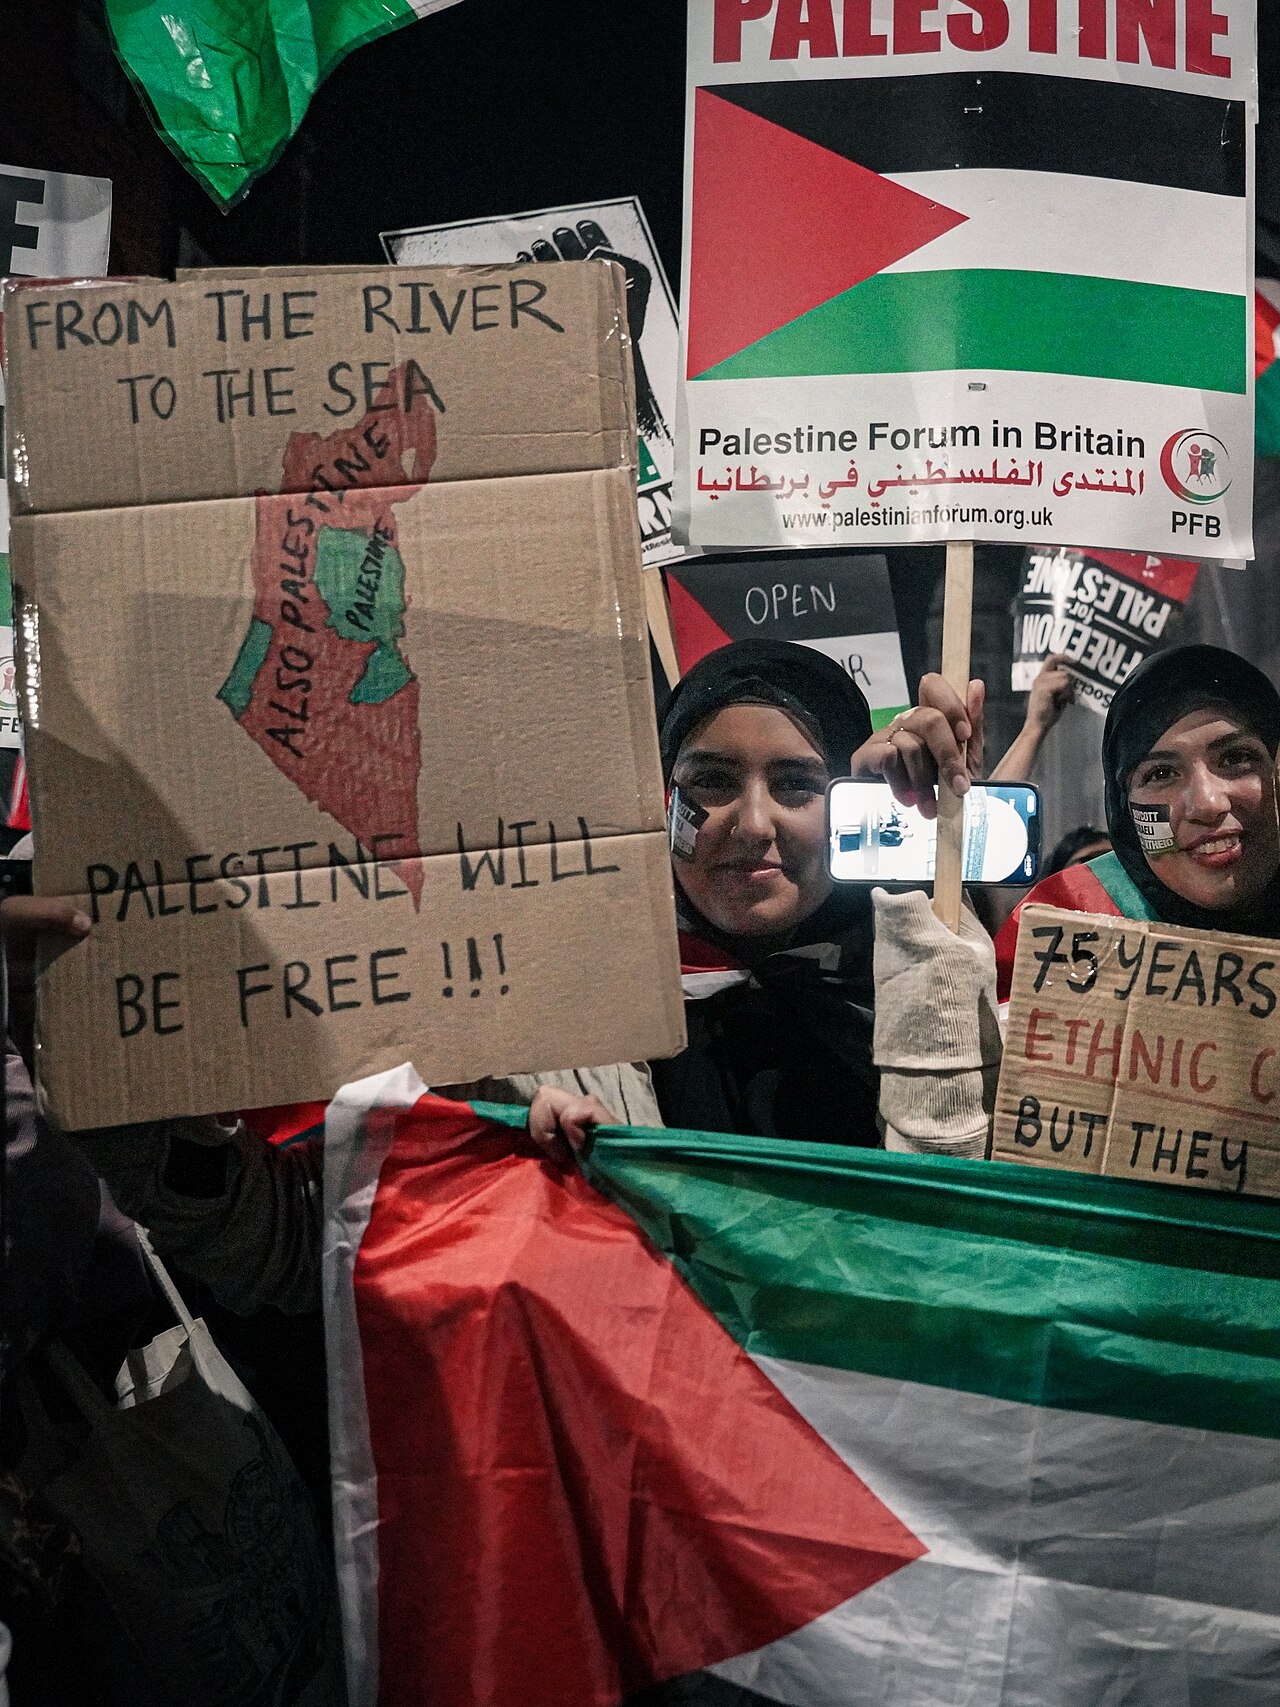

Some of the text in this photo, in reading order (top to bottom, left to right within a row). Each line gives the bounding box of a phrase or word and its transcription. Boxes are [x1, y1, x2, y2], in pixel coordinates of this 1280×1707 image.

[712, 0, 1232, 78] PALESTINE
[26, 278, 564, 350] FROM THE RIVER
[118, 359, 446, 423] TO THE SEA
[700, 420, 1145, 459] Palestine Forum in Britain
[697, 458, 1146, 508] المنتدى الفلسطيني في بريطانيا
[782, 504, 1053, 530] www.palestinianforum.org.uk
[1171, 511, 1222, 538] PFB
[265, 422, 391, 757] ALSO PALESTINE
[344, 522, 395, 632] PALESTINE
[746, 582, 836, 625] OPEN
[1022, 614, 1143, 685] FREEDOM
[1069, 602, 1095, 625] for
[87, 816, 619, 921] PALESTINE WILL
[116, 973, 182, 1037] BE
[237, 947, 410, 1028] FREE
[1032, 925, 1100, 995] 75
[1114, 935, 1278, 1018] YEARS
[1025, 1008, 1218, 1094] ETHNIC
[1015, 1096, 1106, 1154] BUT
[1130, 1122, 1247, 1194] THEY
